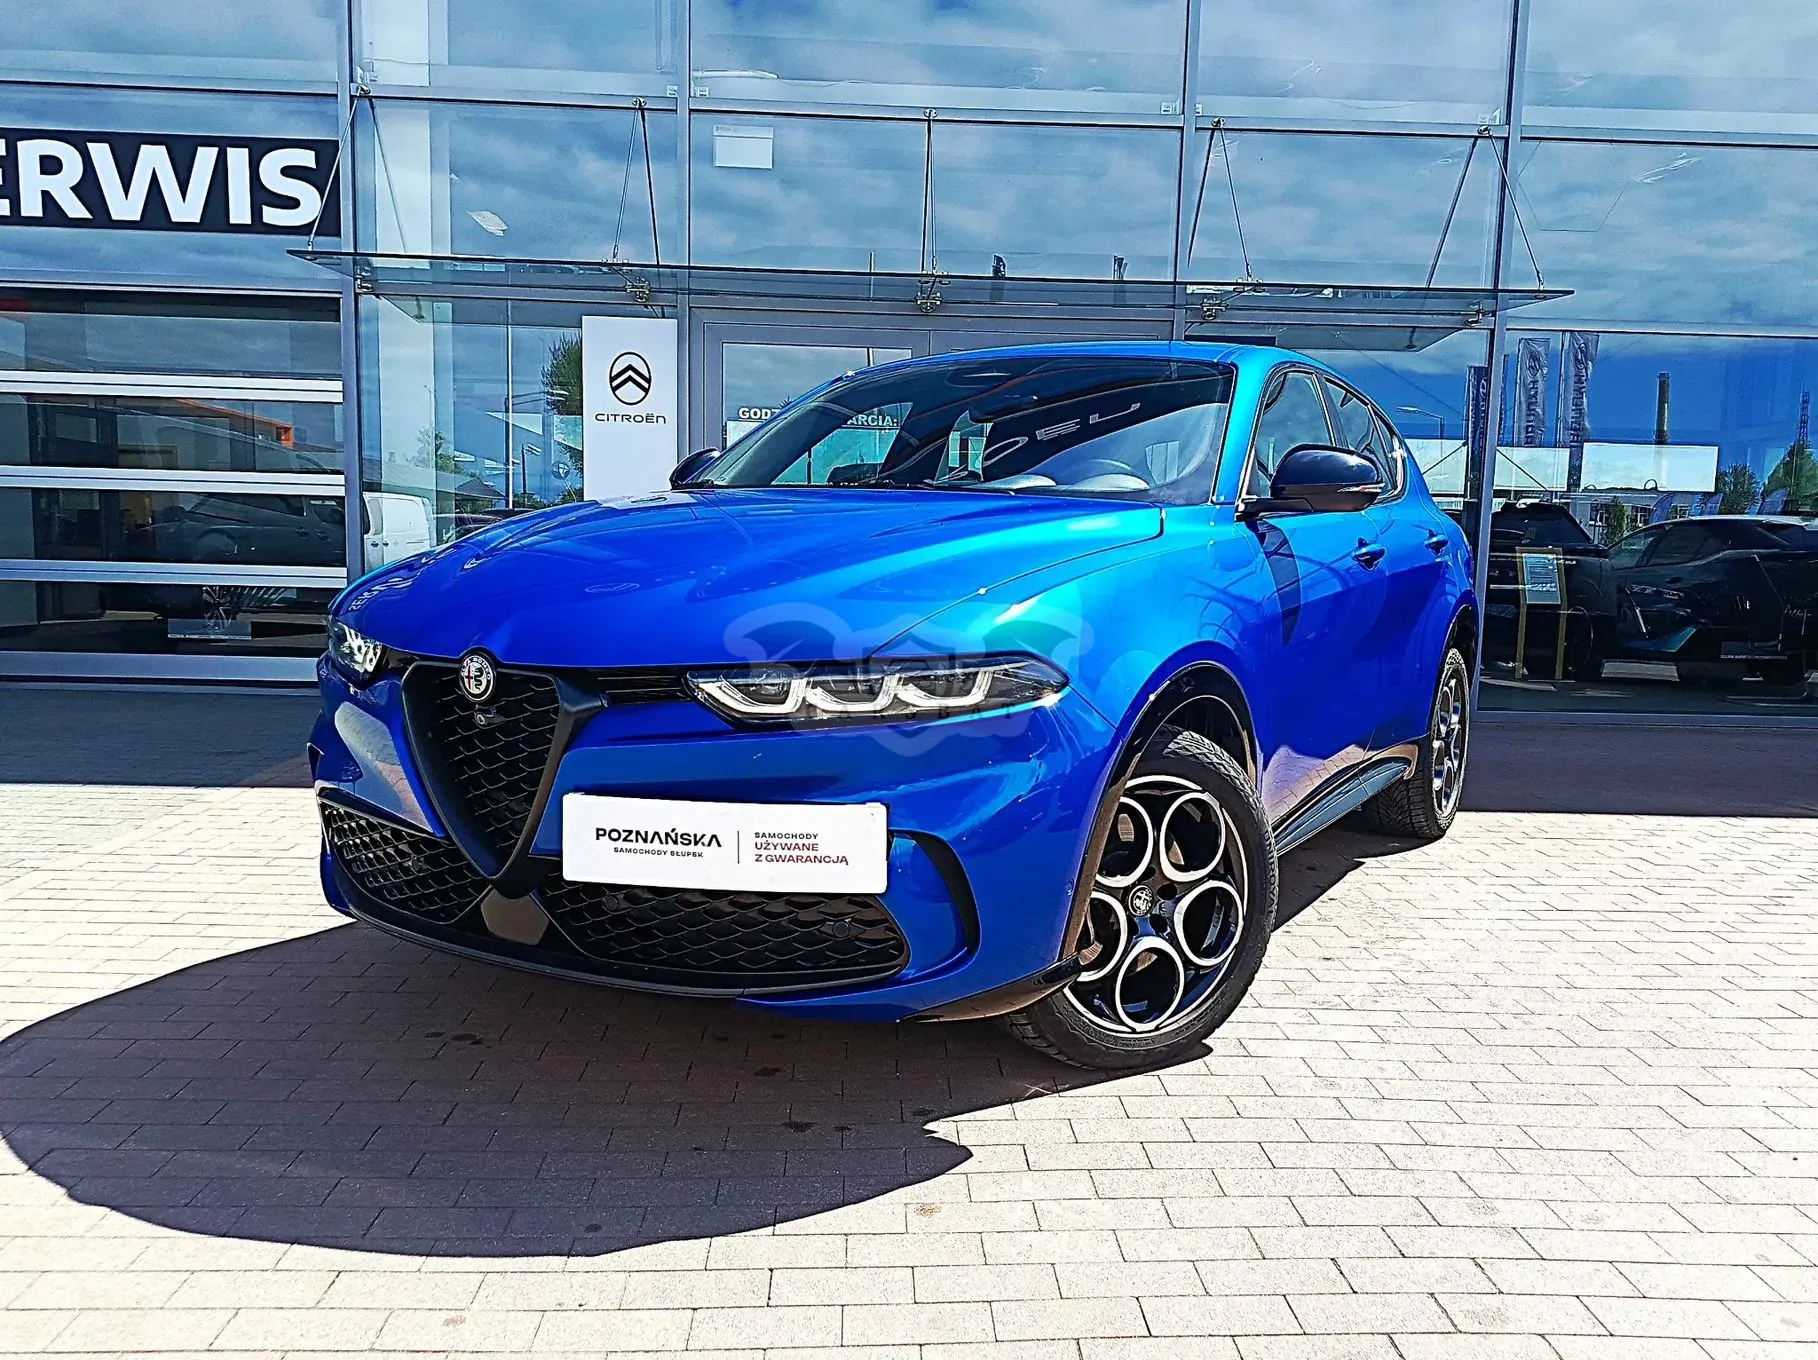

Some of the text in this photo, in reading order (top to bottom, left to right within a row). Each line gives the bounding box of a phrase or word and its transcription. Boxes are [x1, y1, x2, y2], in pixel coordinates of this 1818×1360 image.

[0, 139, 322, 226] RWIS
[595, 412, 667, 424] CITROËN
[595, 828, 722, 847] POZNAŃSKA
[754, 832, 819, 840] SAMOCHODY
[755, 840, 819, 851] UŻYWANE
[613, 847, 704, 858] SAMOCHODY SŁUPSK
[754, 854, 849, 866] Z GWARANCJĄ
